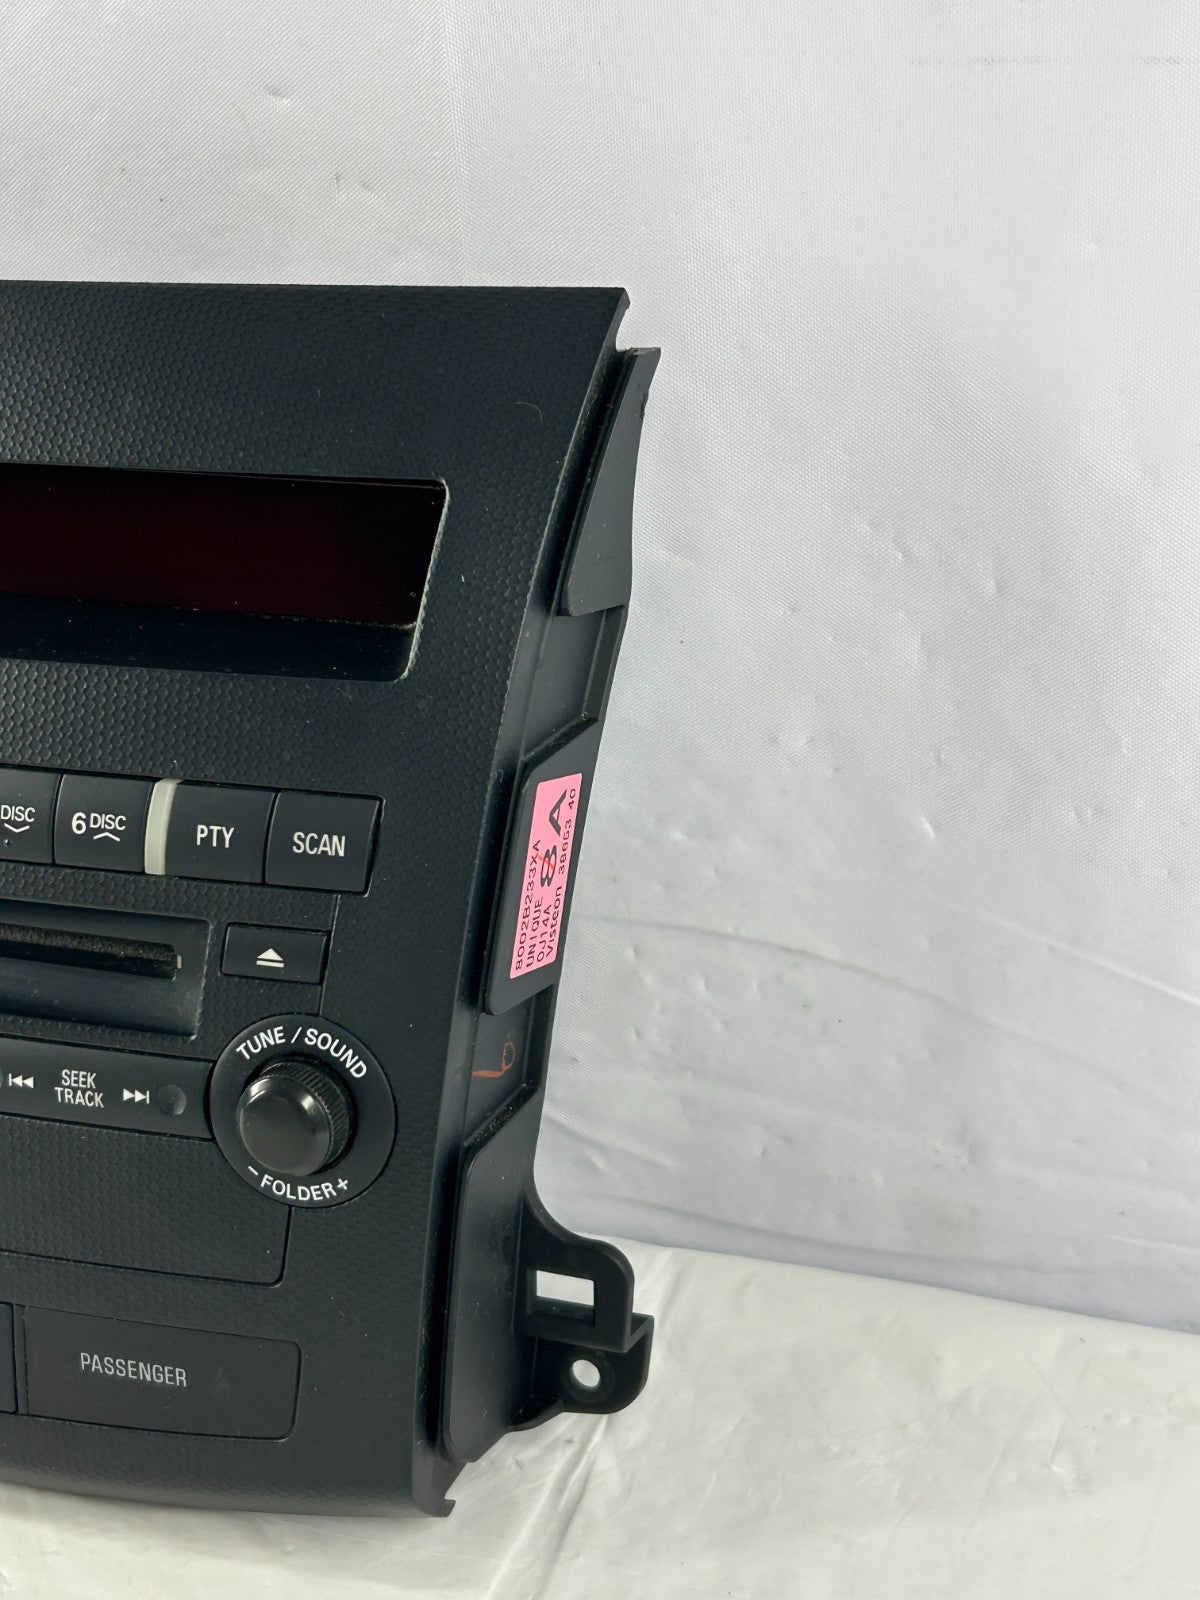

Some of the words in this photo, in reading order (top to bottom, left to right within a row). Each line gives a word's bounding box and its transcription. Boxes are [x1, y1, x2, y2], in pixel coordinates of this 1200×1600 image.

[0, 804, 36, 822] DISC
[71, 811, 87, 836] 6
[89, 812, 127, 831] DISC
[196, 824, 235, 849] PTY
[292, 831, 346, 857] SCAN
[515, 840, 541, 970] 8002B233XA
[546, 886, 562, 959] Visteon
[235, 1025, 286, 1061] TUNE
[303, 1027, 368, 1080] SOUND
[61, 1068, 97, 1090] SEEK
[54, 1086, 105, 1108] TRACK
[80, 1352, 187, 1388] PASSENGER
